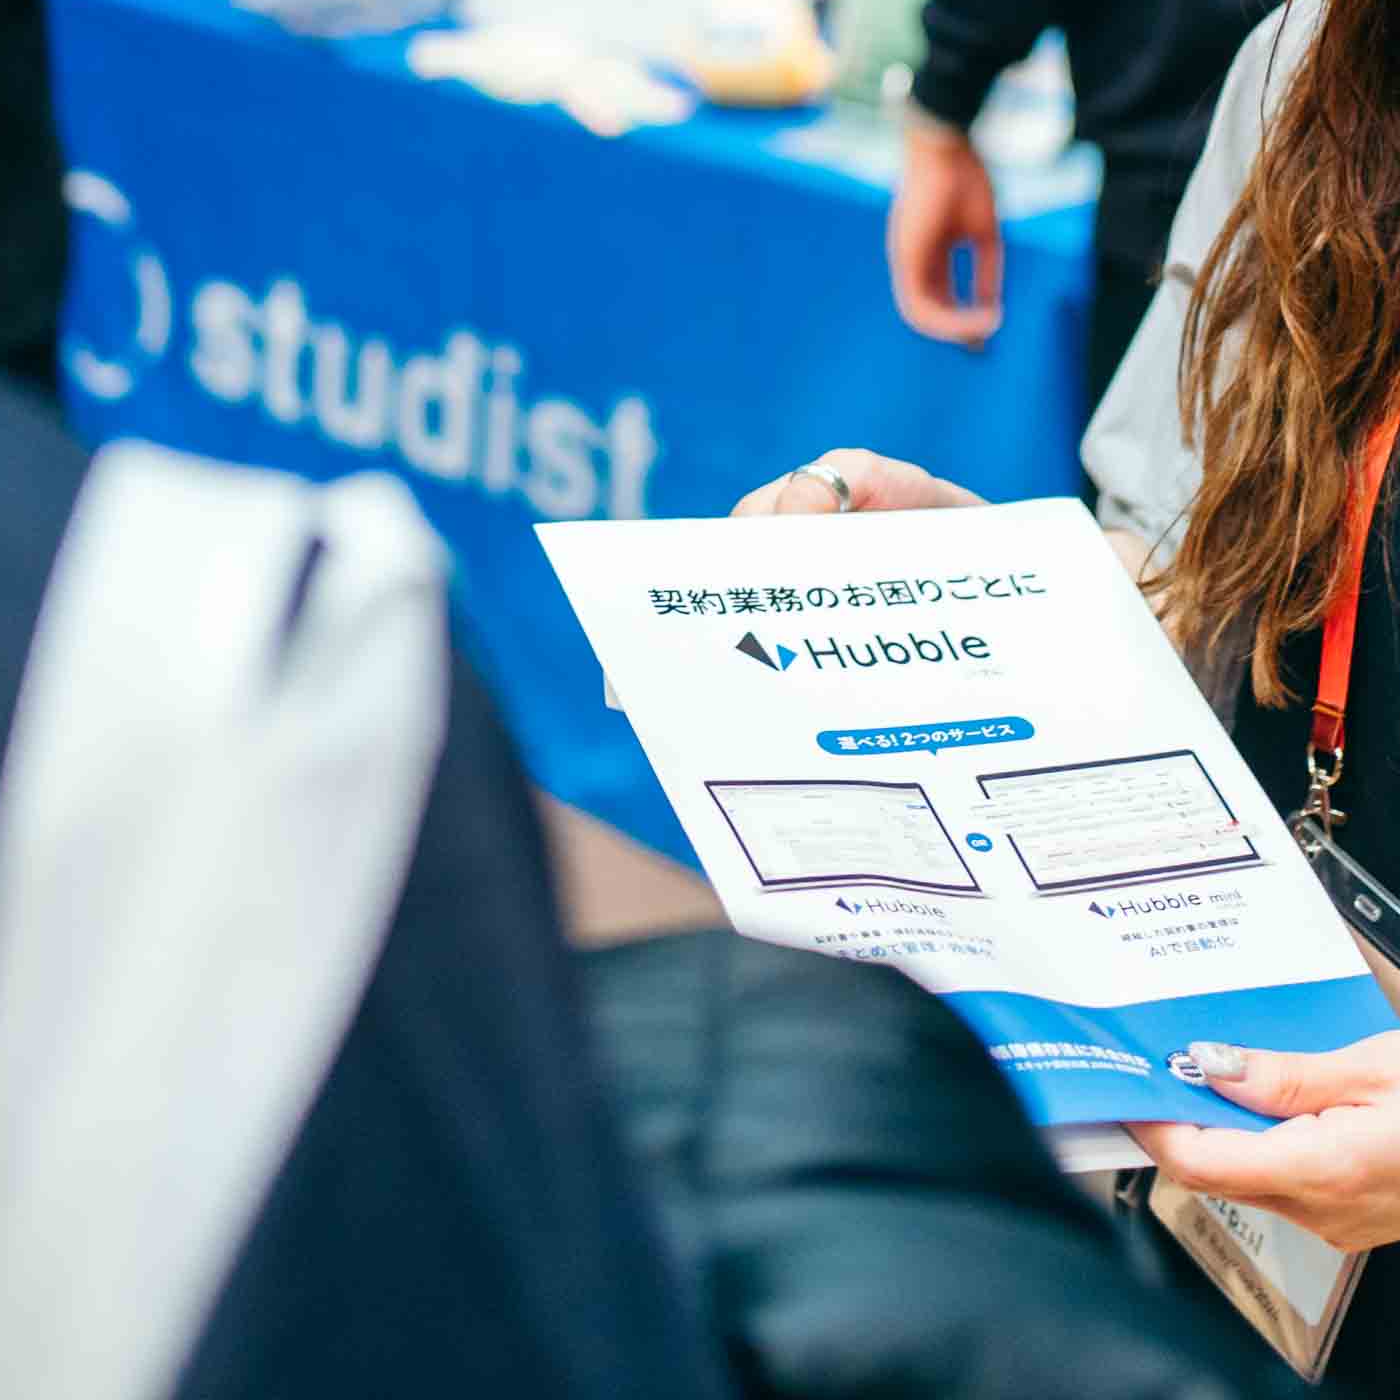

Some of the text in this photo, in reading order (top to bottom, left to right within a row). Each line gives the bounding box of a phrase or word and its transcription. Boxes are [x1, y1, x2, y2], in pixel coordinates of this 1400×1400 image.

[192, 279, 658, 520] studist
[648, 573, 1047, 616] 契約業務のお困りごとに
[804, 630, 992, 670] Hubble
[866, 898, 946, 919] Hubble
[1118, 892, 1202, 917] Hubble
